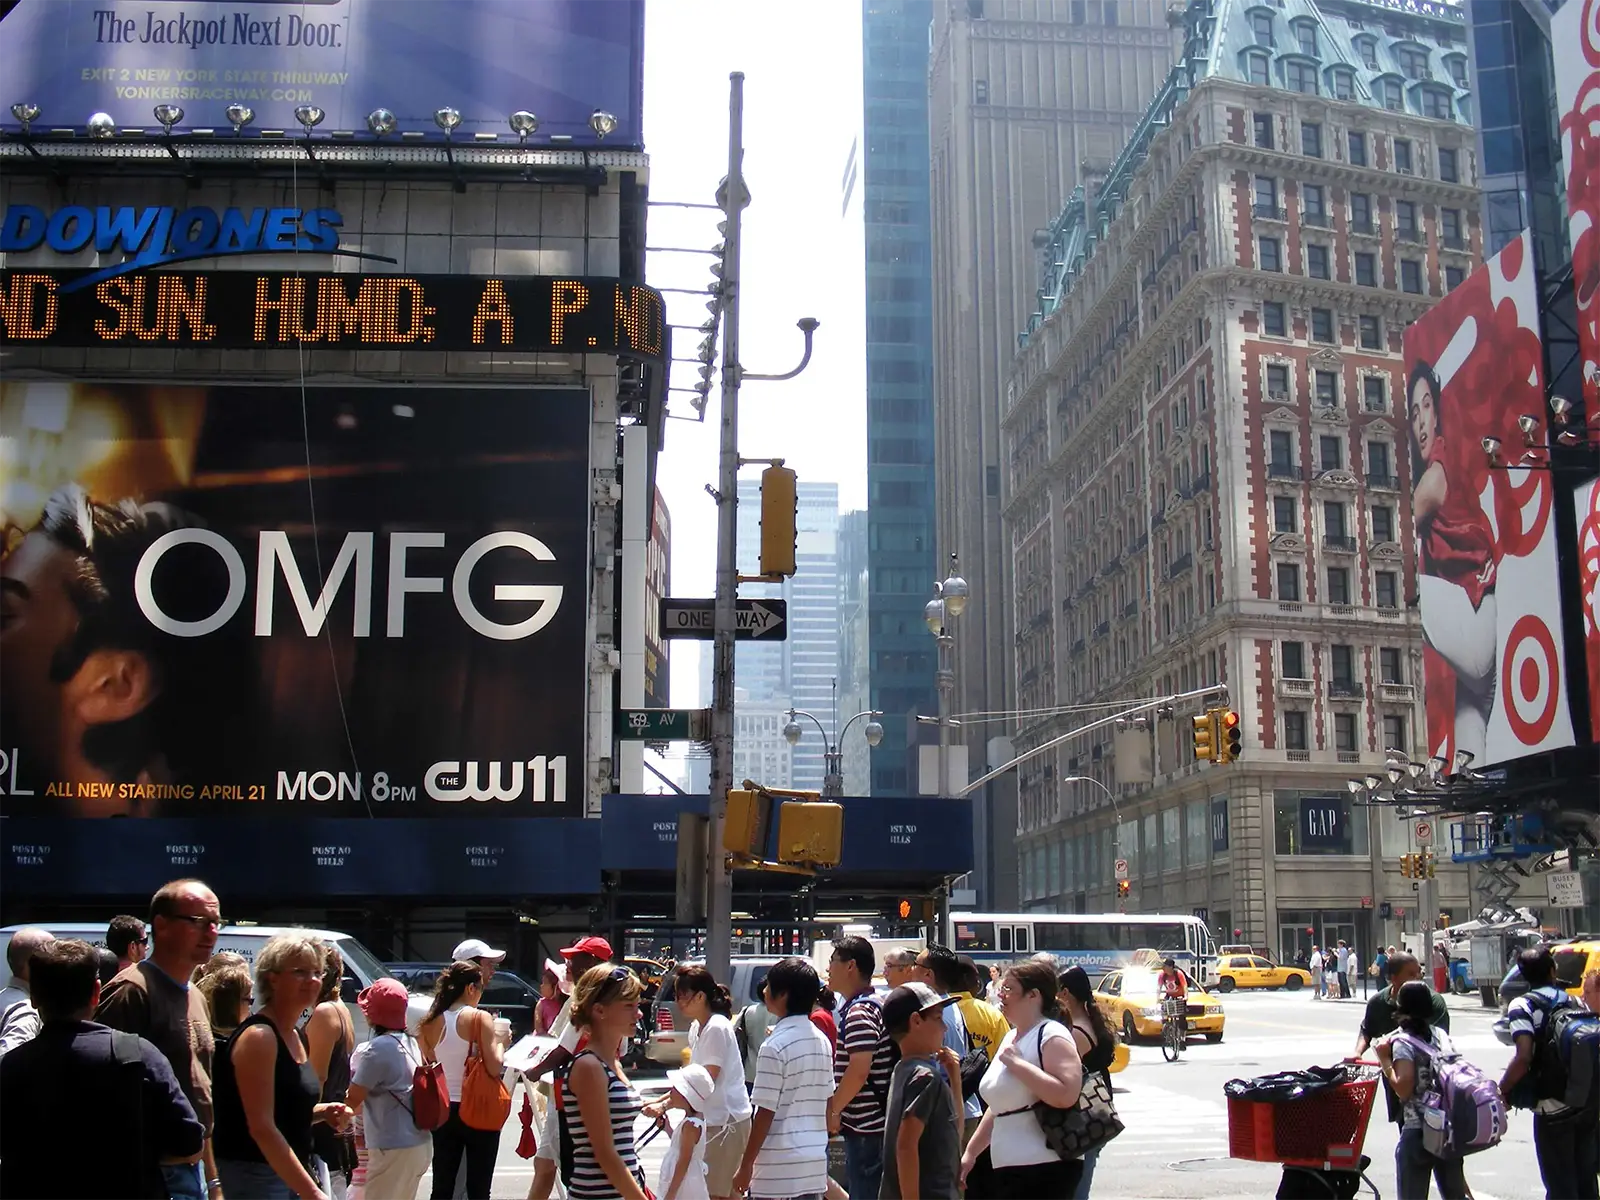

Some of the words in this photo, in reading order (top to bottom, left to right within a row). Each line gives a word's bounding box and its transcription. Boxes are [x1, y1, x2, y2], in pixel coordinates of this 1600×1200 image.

[94, 10, 136, 43] The
[139, 12, 227, 50] Jackpot
[232, 13, 283, 46] Next
[287, 14, 342, 48] Door.
[81, 68, 116, 81] EXIT
[119, 69, 131, 81] 2
[134, 69, 171, 81] NEW
[176, 69, 217, 83] YORK
[225, 70, 267, 83] STATE
[271, 71, 348, 85] THRUWAY
[115, 86, 313, 102] YONKERSRACEWAY.COM
[472, 279, 514, 344] A
[134, 527, 564, 640] OMFG
[677, 611, 712, 628] ONE
[735, 612, 771, 628] WAY
[659, 712, 676, 726] AV
[276, 771, 362, 802] MON
[440, 777, 459, 786] THE
[45, 782, 74, 798] ALL
[77, 782, 116, 798] NEW
[118, 783, 195, 800] STARTING
[200, 785, 245, 800] APRIL
[248, 785, 266, 801] 21
[1308, 809, 1336, 836] GAP
[1052, 953, 1112, 966] Barcelona
